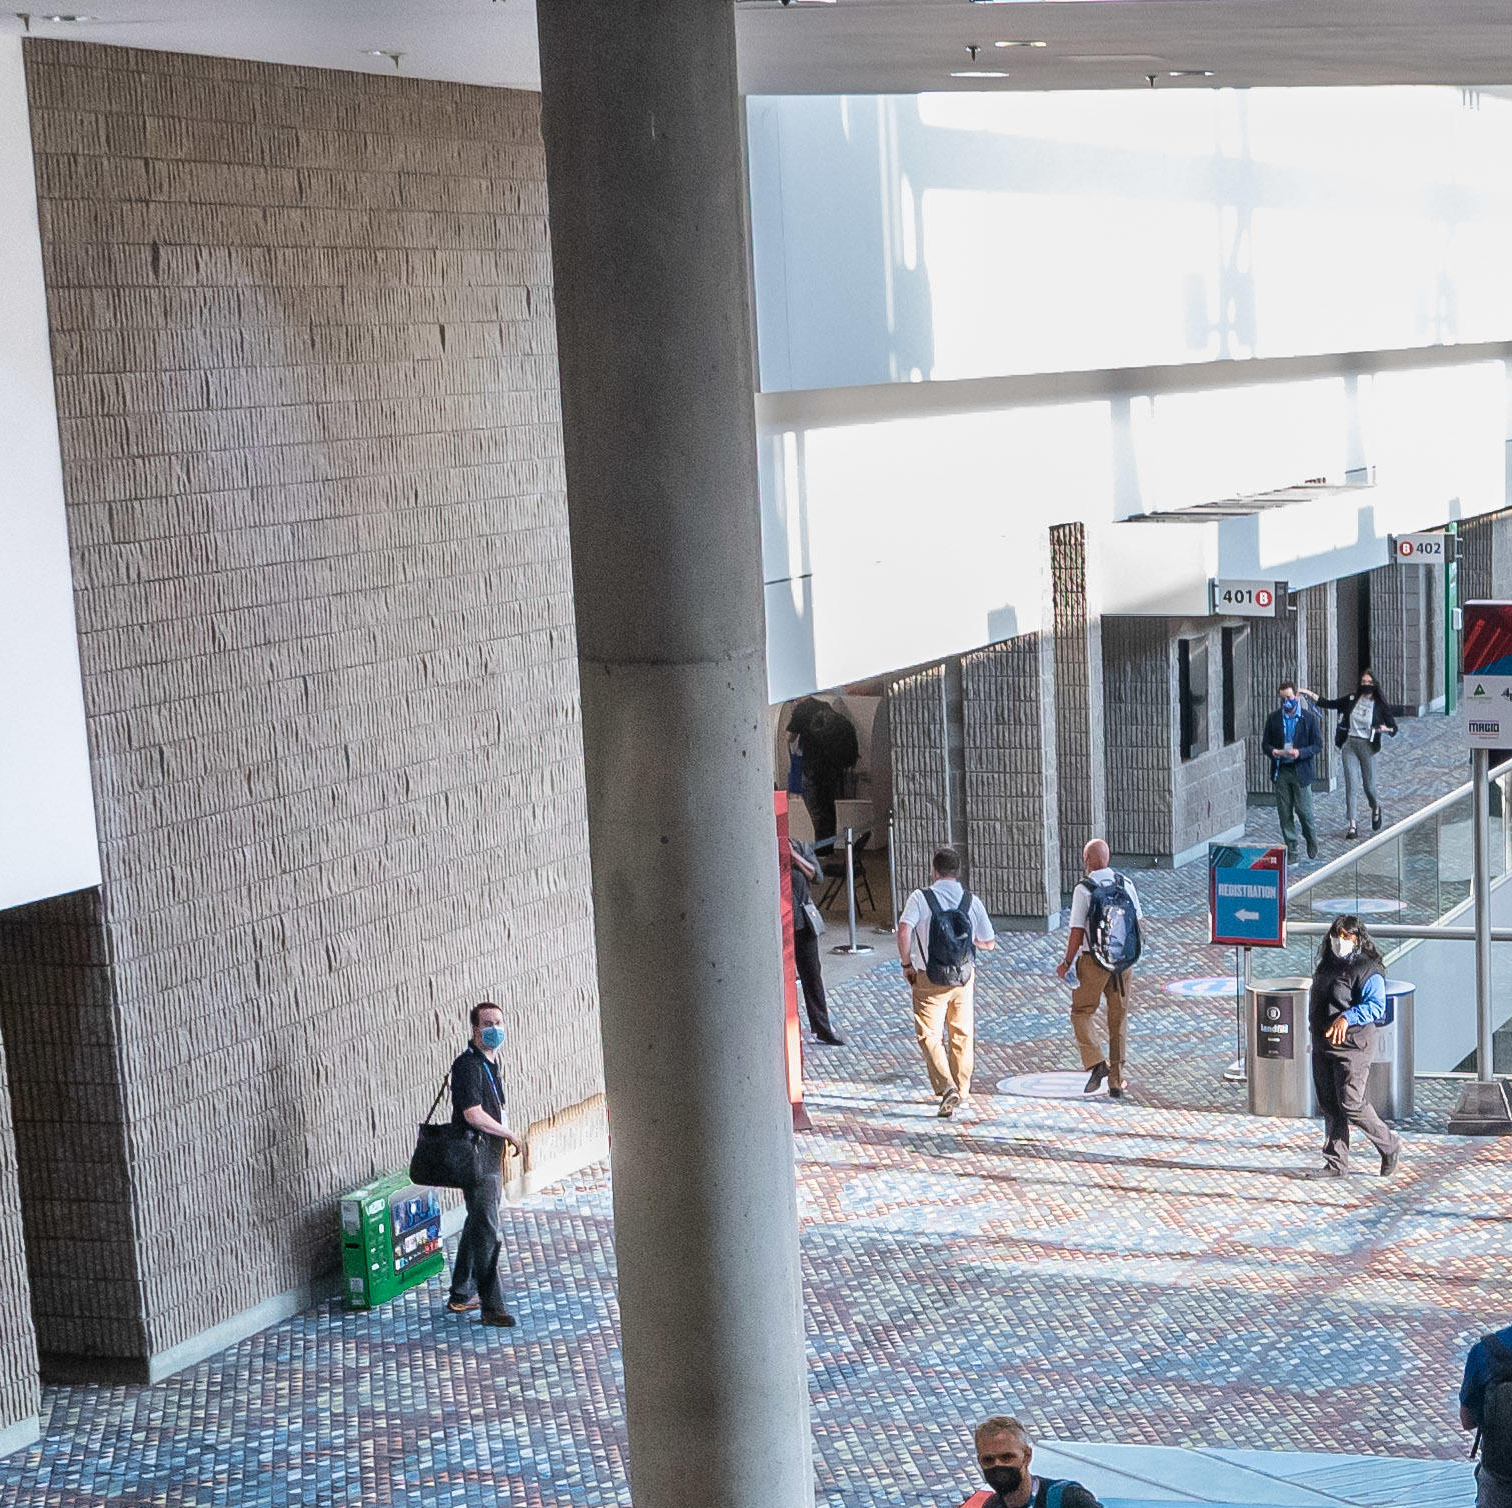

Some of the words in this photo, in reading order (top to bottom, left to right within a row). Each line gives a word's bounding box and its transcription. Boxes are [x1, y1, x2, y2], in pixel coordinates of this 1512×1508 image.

[1416, 543, 1442, 555] 402
[1223, 589, 1253, 604] 401
[1218, 883, 1277, 899] REGISTRATION
